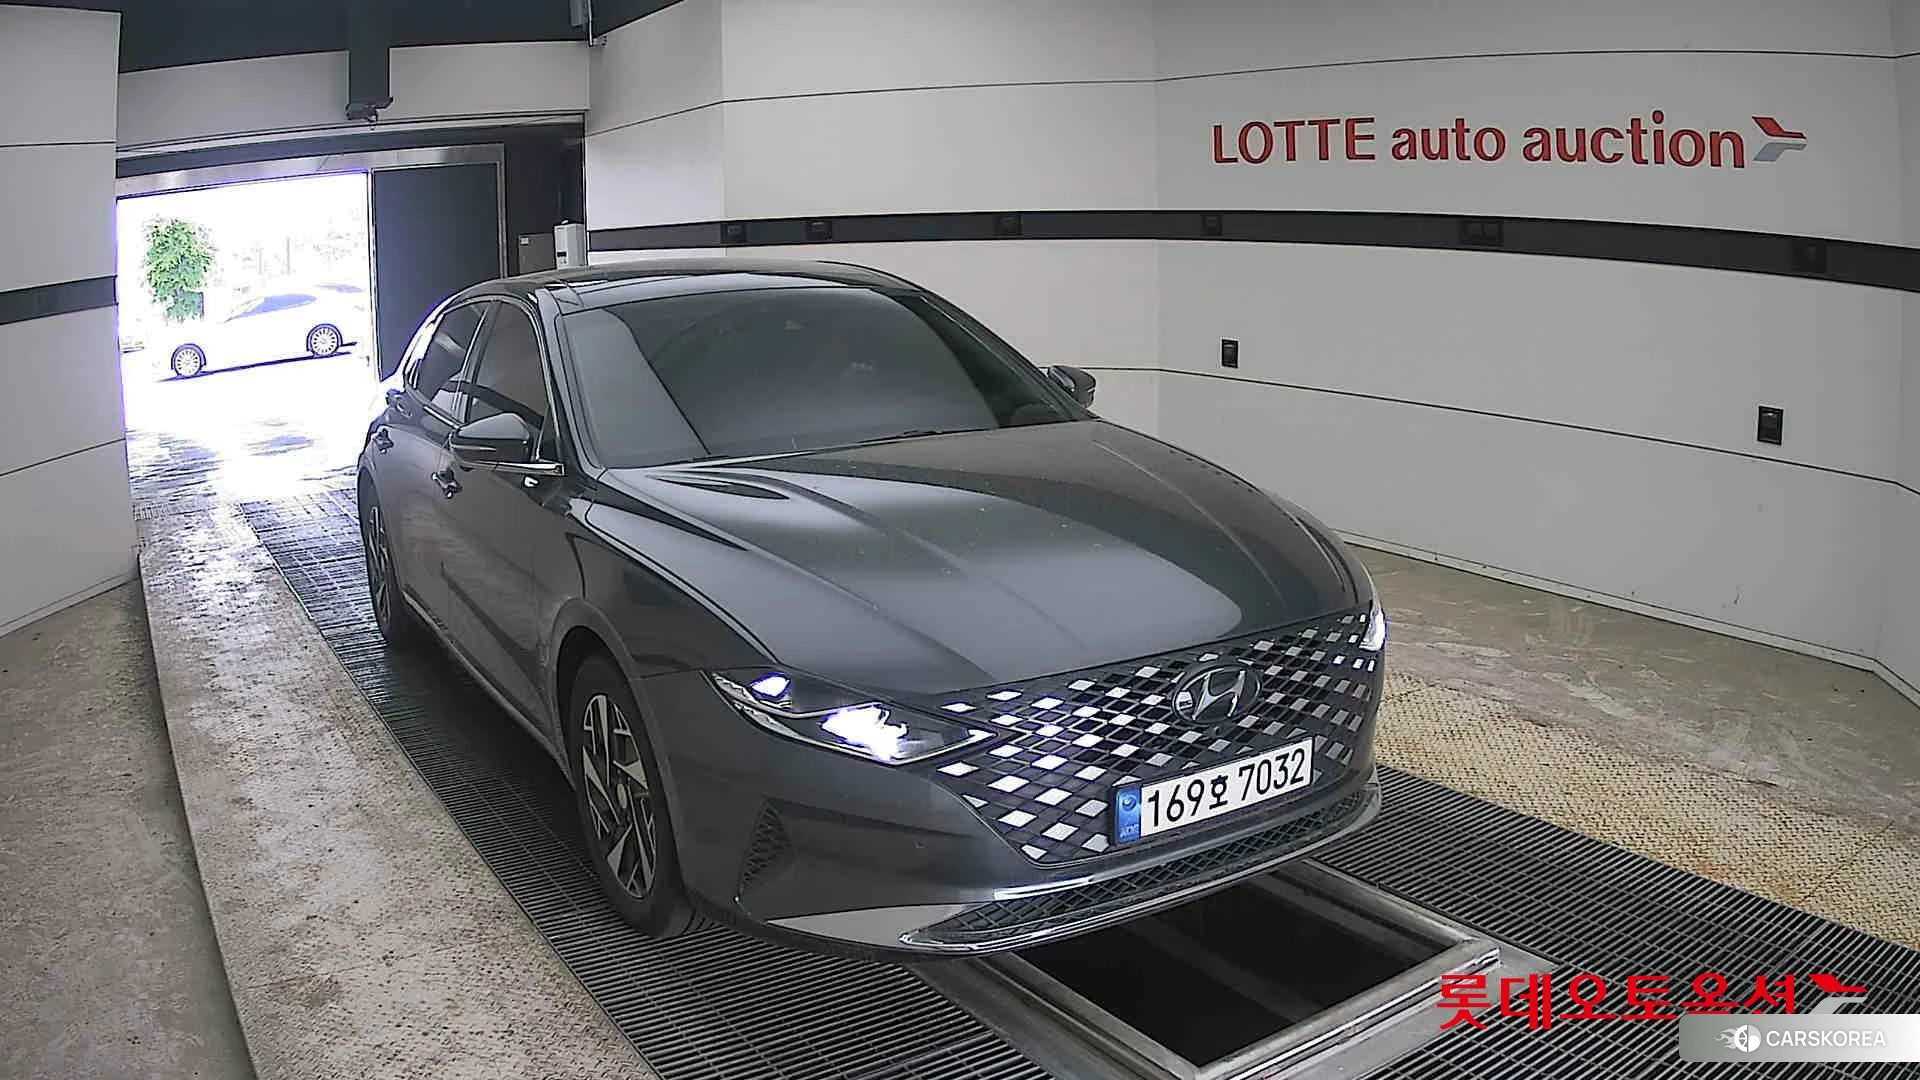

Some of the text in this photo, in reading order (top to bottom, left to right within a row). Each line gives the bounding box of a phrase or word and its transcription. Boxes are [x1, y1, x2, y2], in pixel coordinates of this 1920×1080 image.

[1212, 109, 1746, 169] LOTTE auto auction
[1147, 747, 1306, 828] 169호 7032
